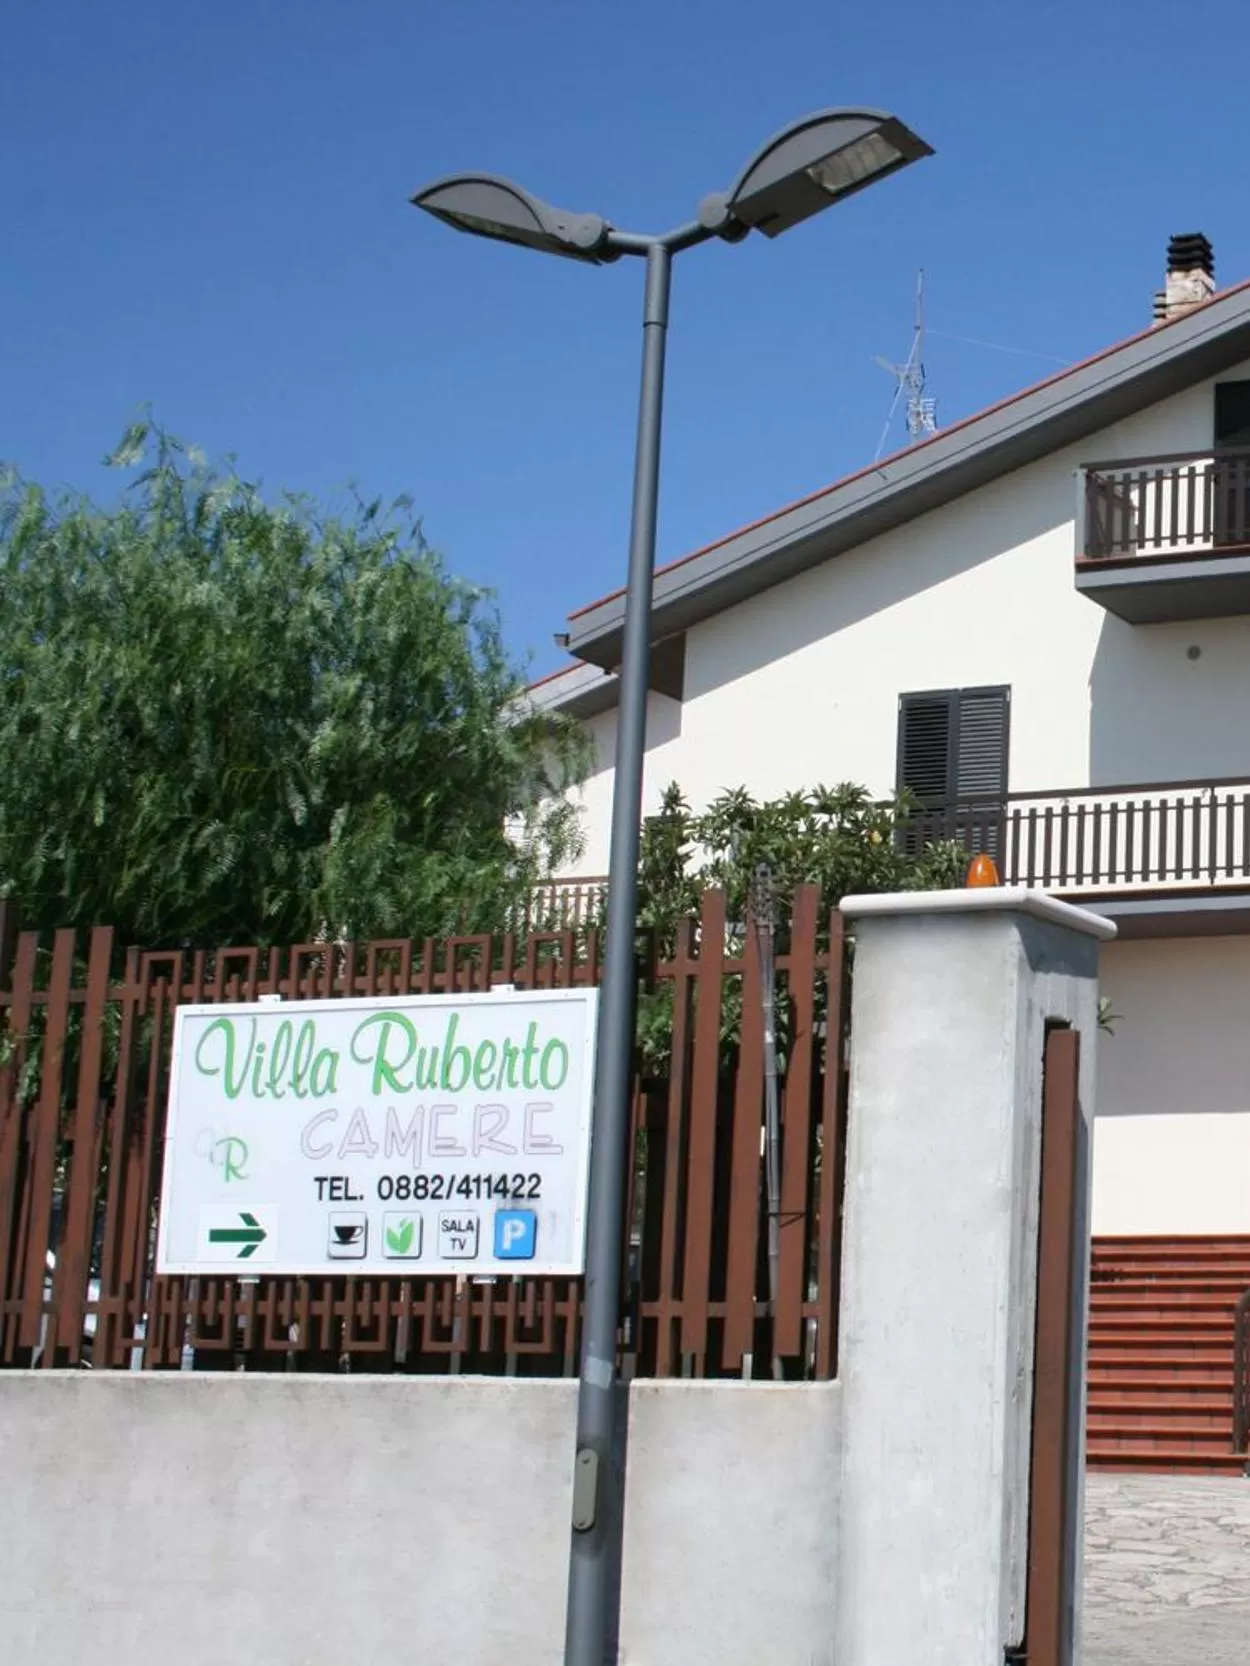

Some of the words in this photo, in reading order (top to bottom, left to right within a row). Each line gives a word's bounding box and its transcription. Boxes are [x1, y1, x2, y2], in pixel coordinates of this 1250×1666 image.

[195, 1016, 339, 1099] Villa
[350, 1011, 569, 1096] Ruberto
[300, 1102, 564, 1168] CAMERE
[314, 1176, 364, 1201] TEL.
[377, 1173, 542, 1200] 0882/411422
[441, 1219, 475, 1233] SALA
[502, 1218, 526, 1250] P
[450, 1236, 468, 1251] TV
